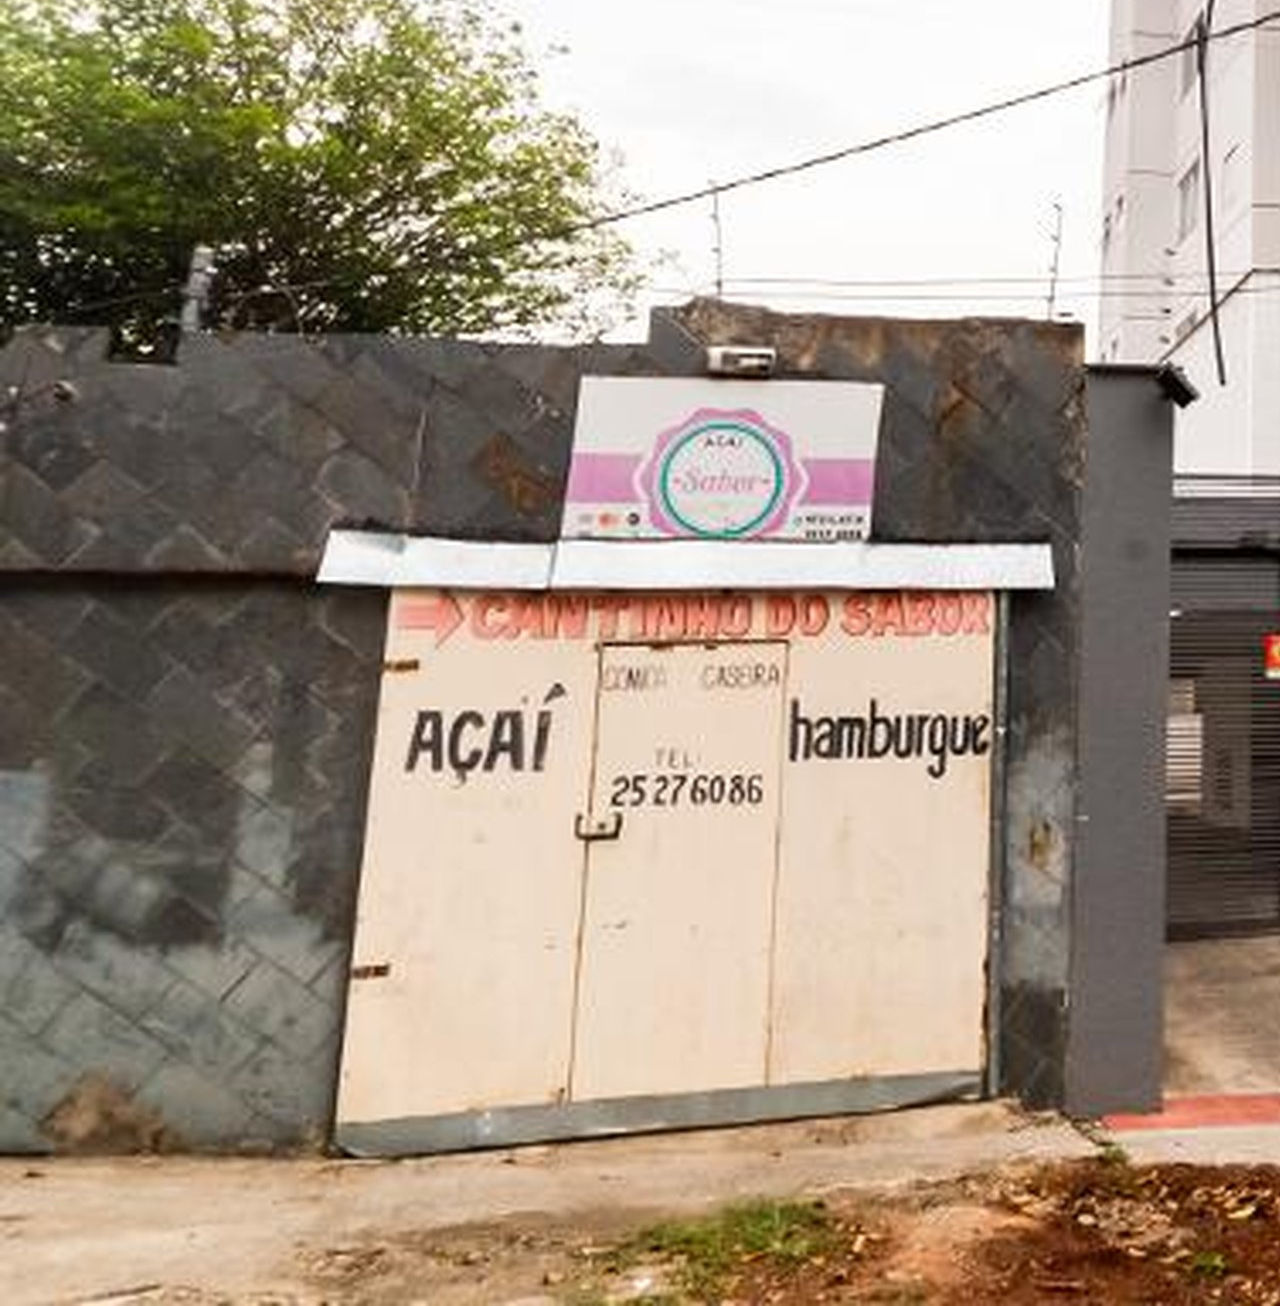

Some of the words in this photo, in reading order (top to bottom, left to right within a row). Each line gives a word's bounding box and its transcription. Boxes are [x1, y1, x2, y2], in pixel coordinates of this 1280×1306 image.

[764, 594, 831, 637] DO
[404, 681, 567, 788] AÇAÍ
[789, 698, 990, 779] hamburgue
